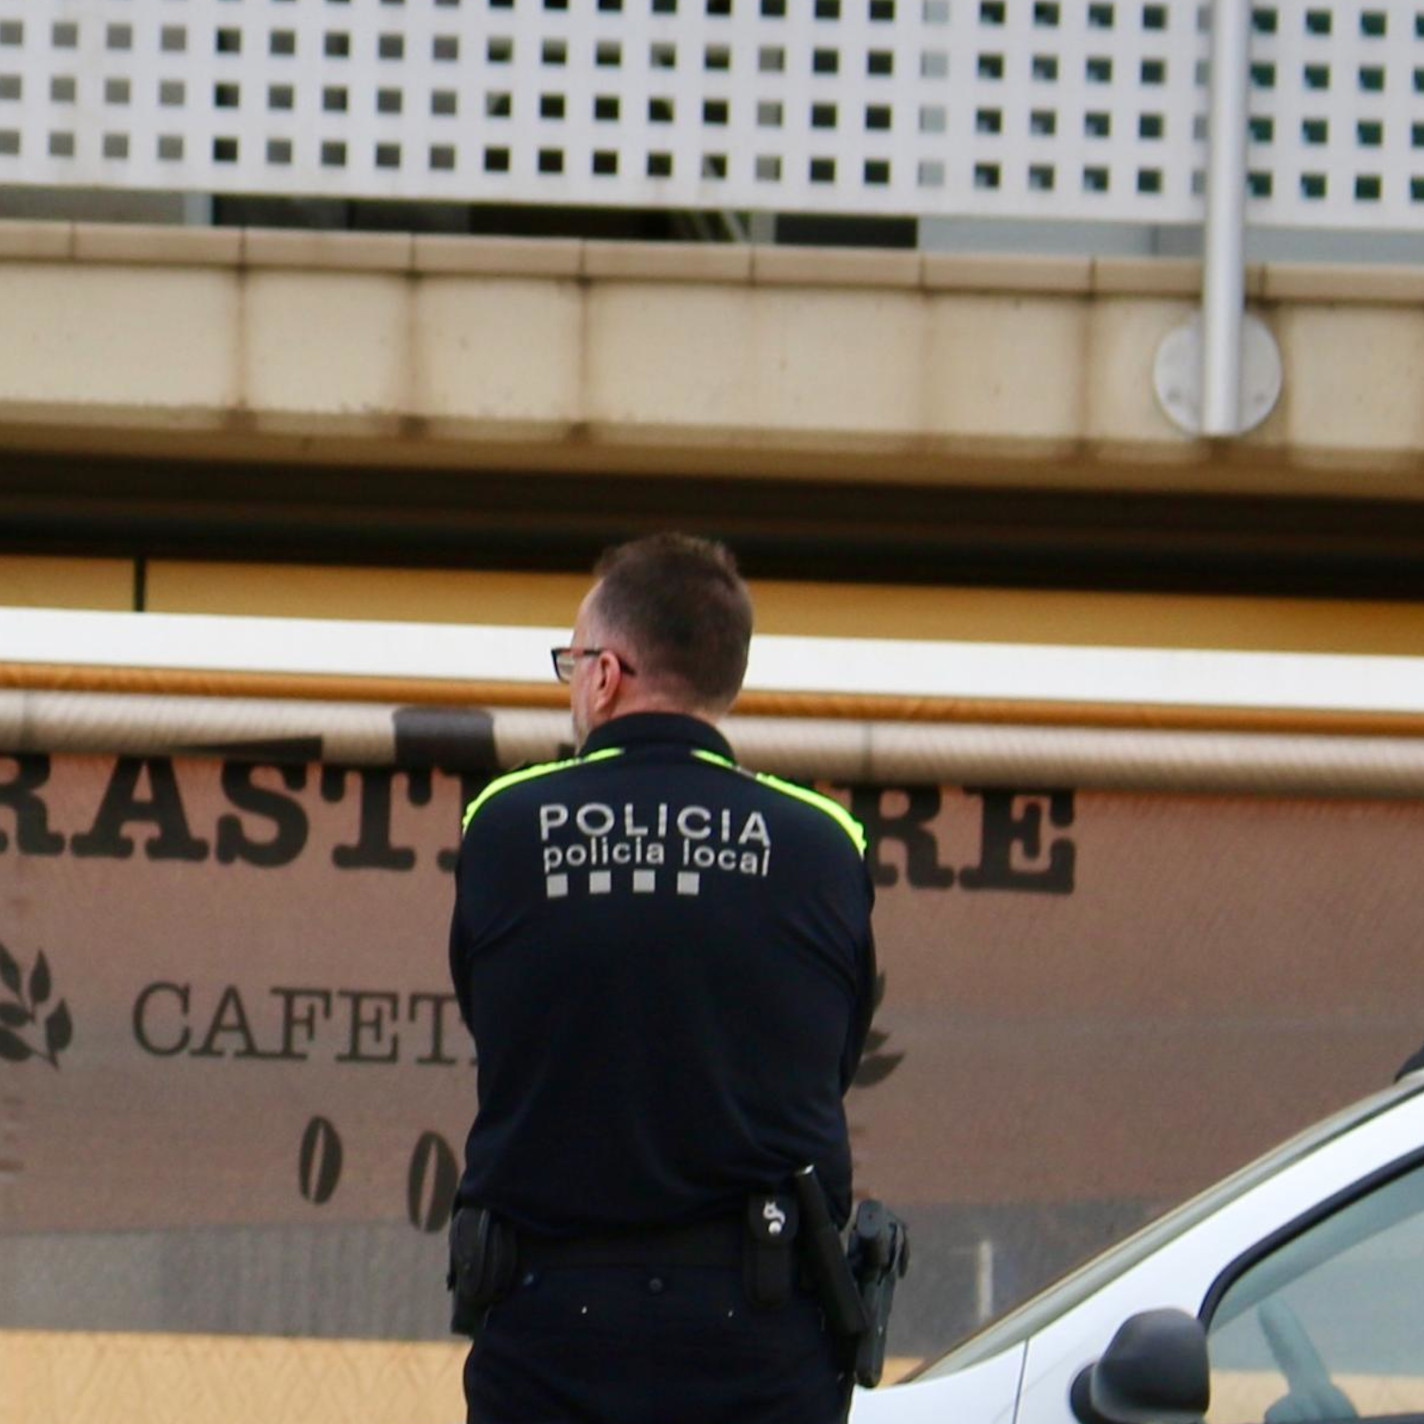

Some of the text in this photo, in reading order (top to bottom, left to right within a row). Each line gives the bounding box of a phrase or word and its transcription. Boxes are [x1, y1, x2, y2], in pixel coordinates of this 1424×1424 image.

[539, 803, 771, 847] POLICIA
[543, 836, 771, 877] policia local
[131, 981, 478, 1068] CAFET
